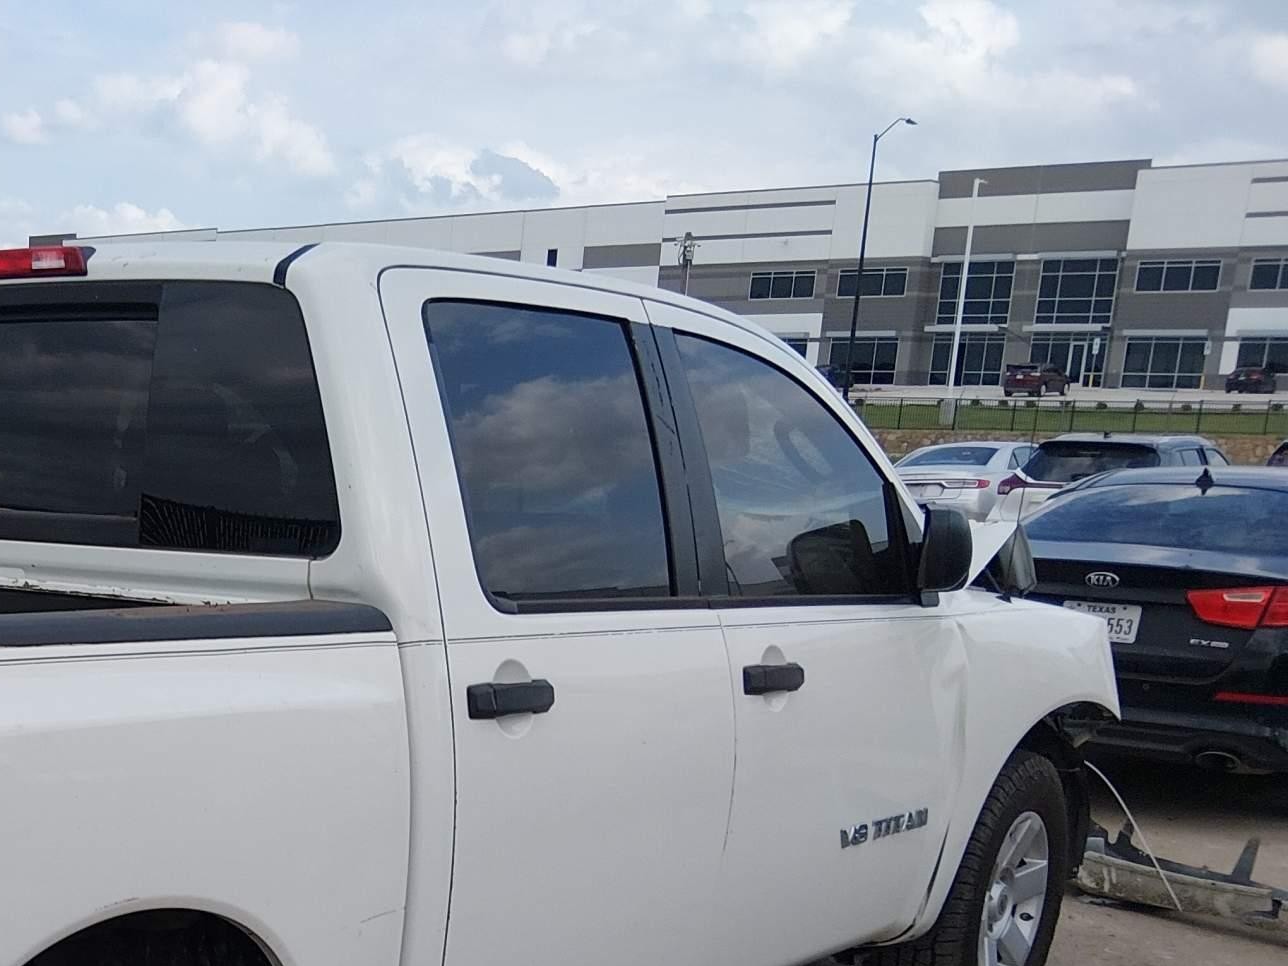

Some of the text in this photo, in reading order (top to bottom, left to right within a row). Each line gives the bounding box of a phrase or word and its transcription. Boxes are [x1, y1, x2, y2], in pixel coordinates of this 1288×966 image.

[1087, 604, 1116, 614] TEXAS
[840, 807, 929, 849] V8 TITAN
